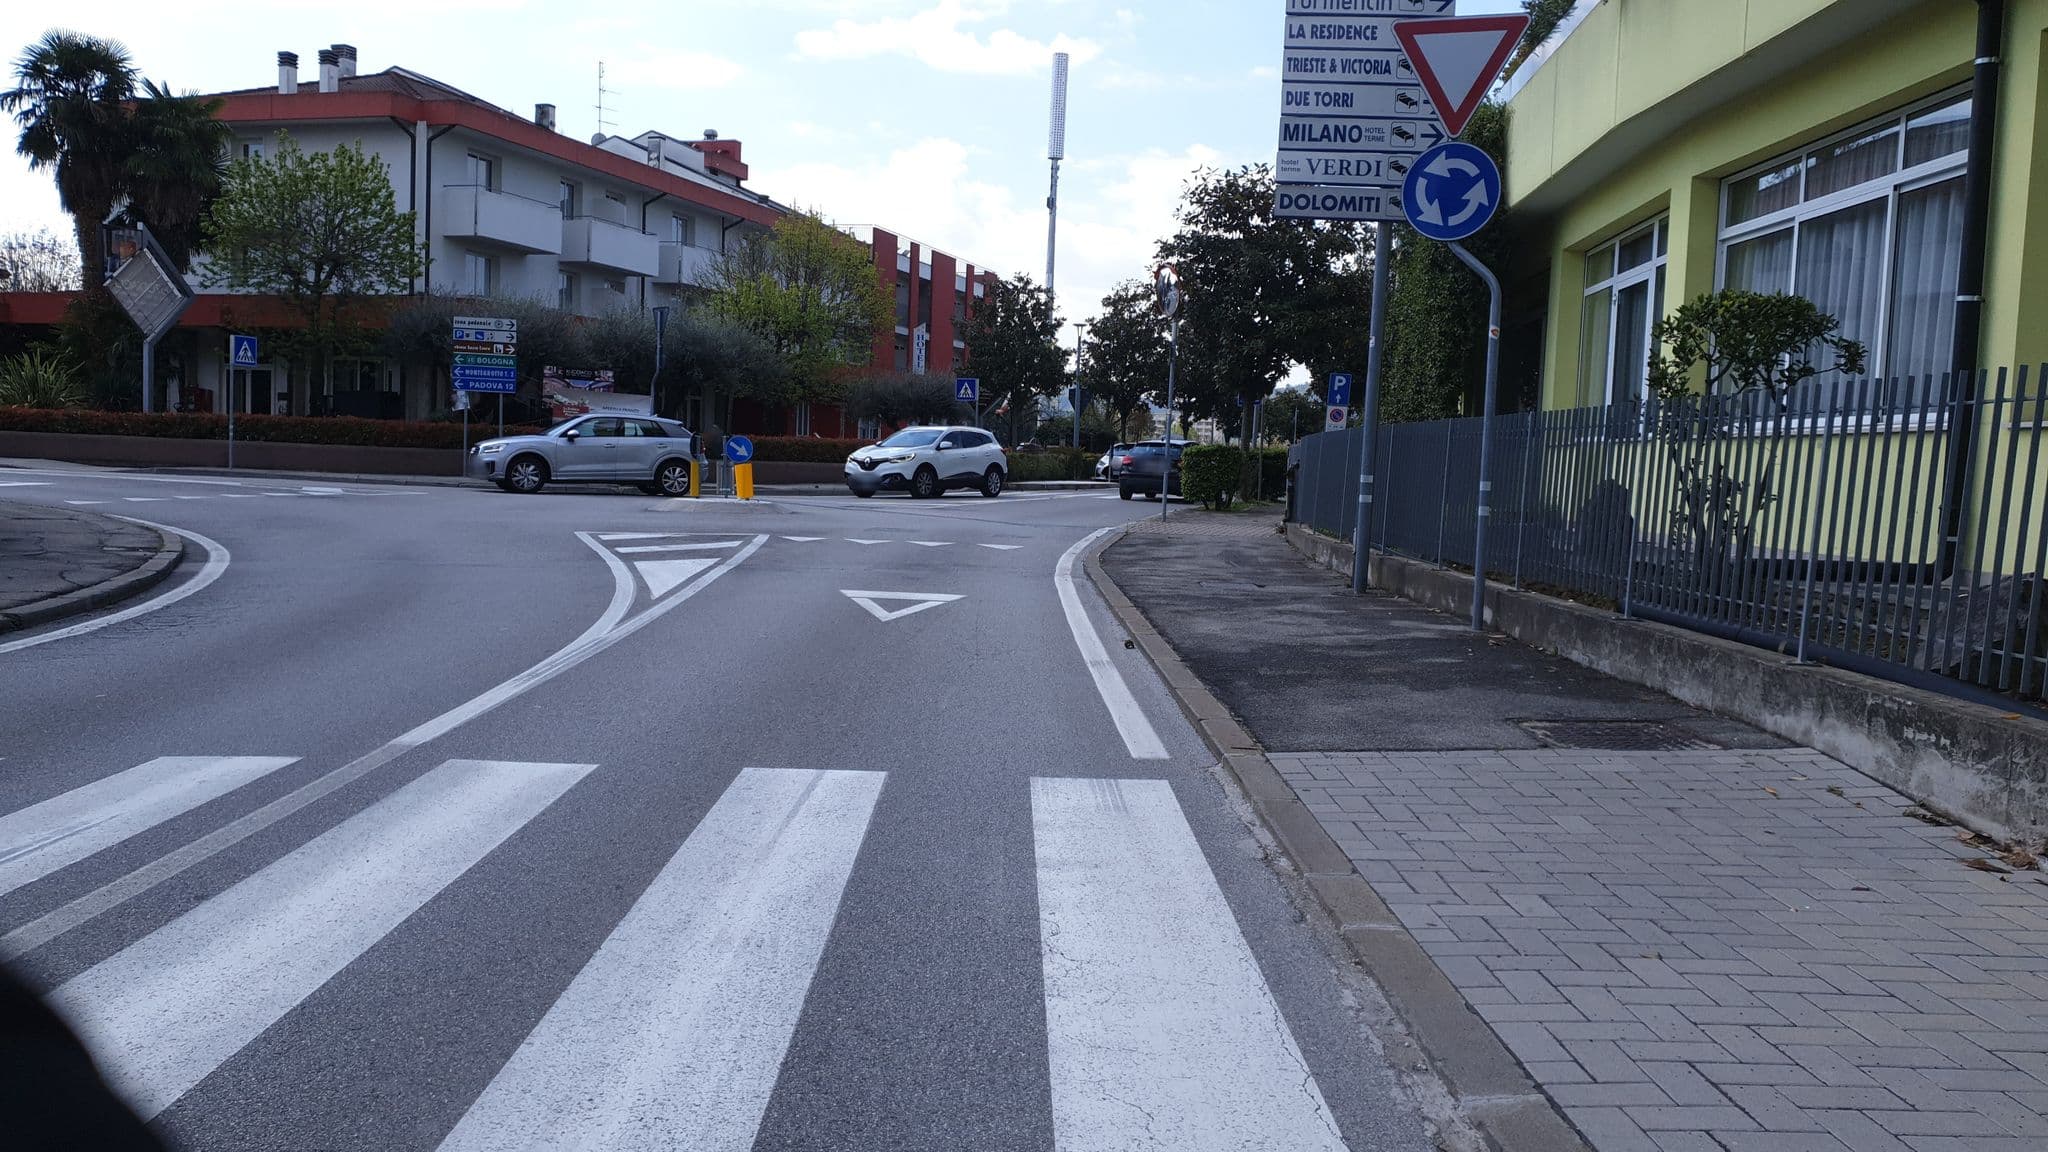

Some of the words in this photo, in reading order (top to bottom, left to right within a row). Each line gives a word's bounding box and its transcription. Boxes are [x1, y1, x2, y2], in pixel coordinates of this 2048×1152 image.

[1288, 23, 1306, 39] LA
[1310, 24, 1378, 41] RESIDENCE
[1287, 57, 1327, 74] TRIESTE
[1329, 59, 1337, 73] &
[1340, 58, 1392, 75] VICTORIA
[1285, 90, 1311, 107] DUE
[1314, 92, 1354, 108] TORRI
[1283, 123, 1362, 144] MILANO
[1364, 135, 1385, 143] TERME
[1306, 158, 1384, 177] VERDI
[1279, 193, 1380, 213] DOLOMITI
[916, 335, 924, 368] HOTEL
[477, 357, 514, 365] BOLOGNA
[469, 381, 503, 390] PADOVA
[1334, 376, 1347, 390] P
